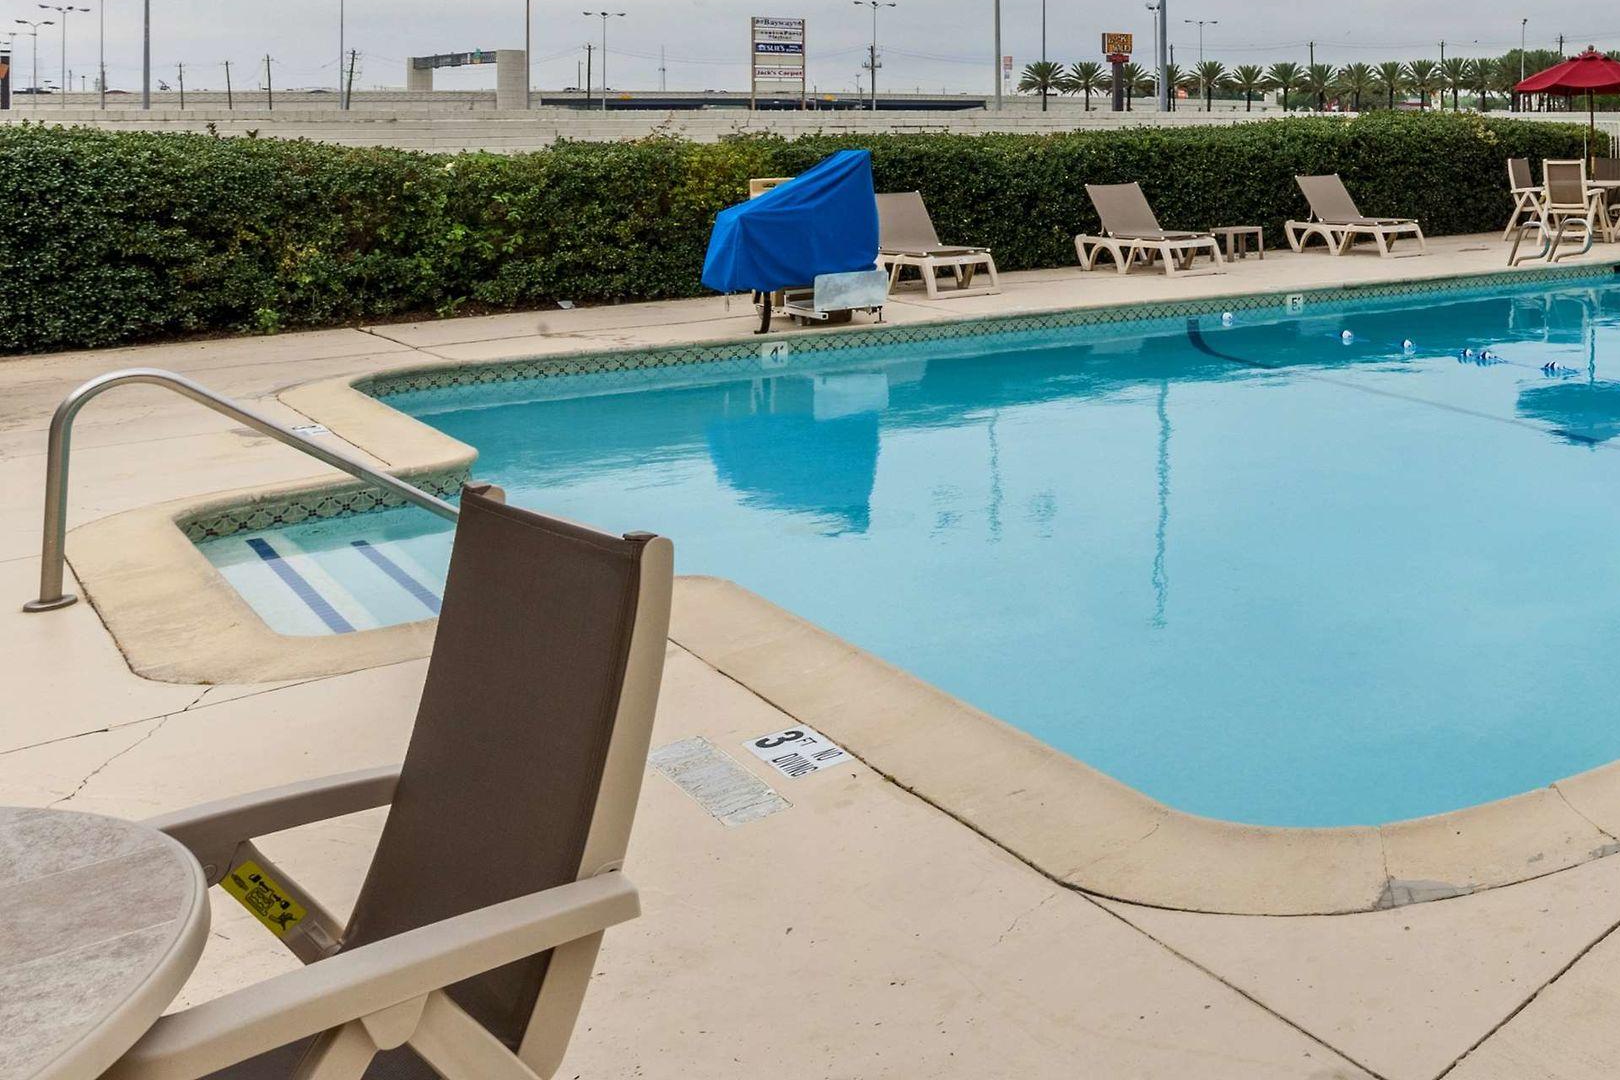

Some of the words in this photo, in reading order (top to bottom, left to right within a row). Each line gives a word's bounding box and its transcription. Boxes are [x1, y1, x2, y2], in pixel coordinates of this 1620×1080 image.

[755, 730, 804, 749] 3
[795, 737, 818, 747] FT
[811, 748, 843, 761] NO
[772, 753, 819, 777] DIVING
